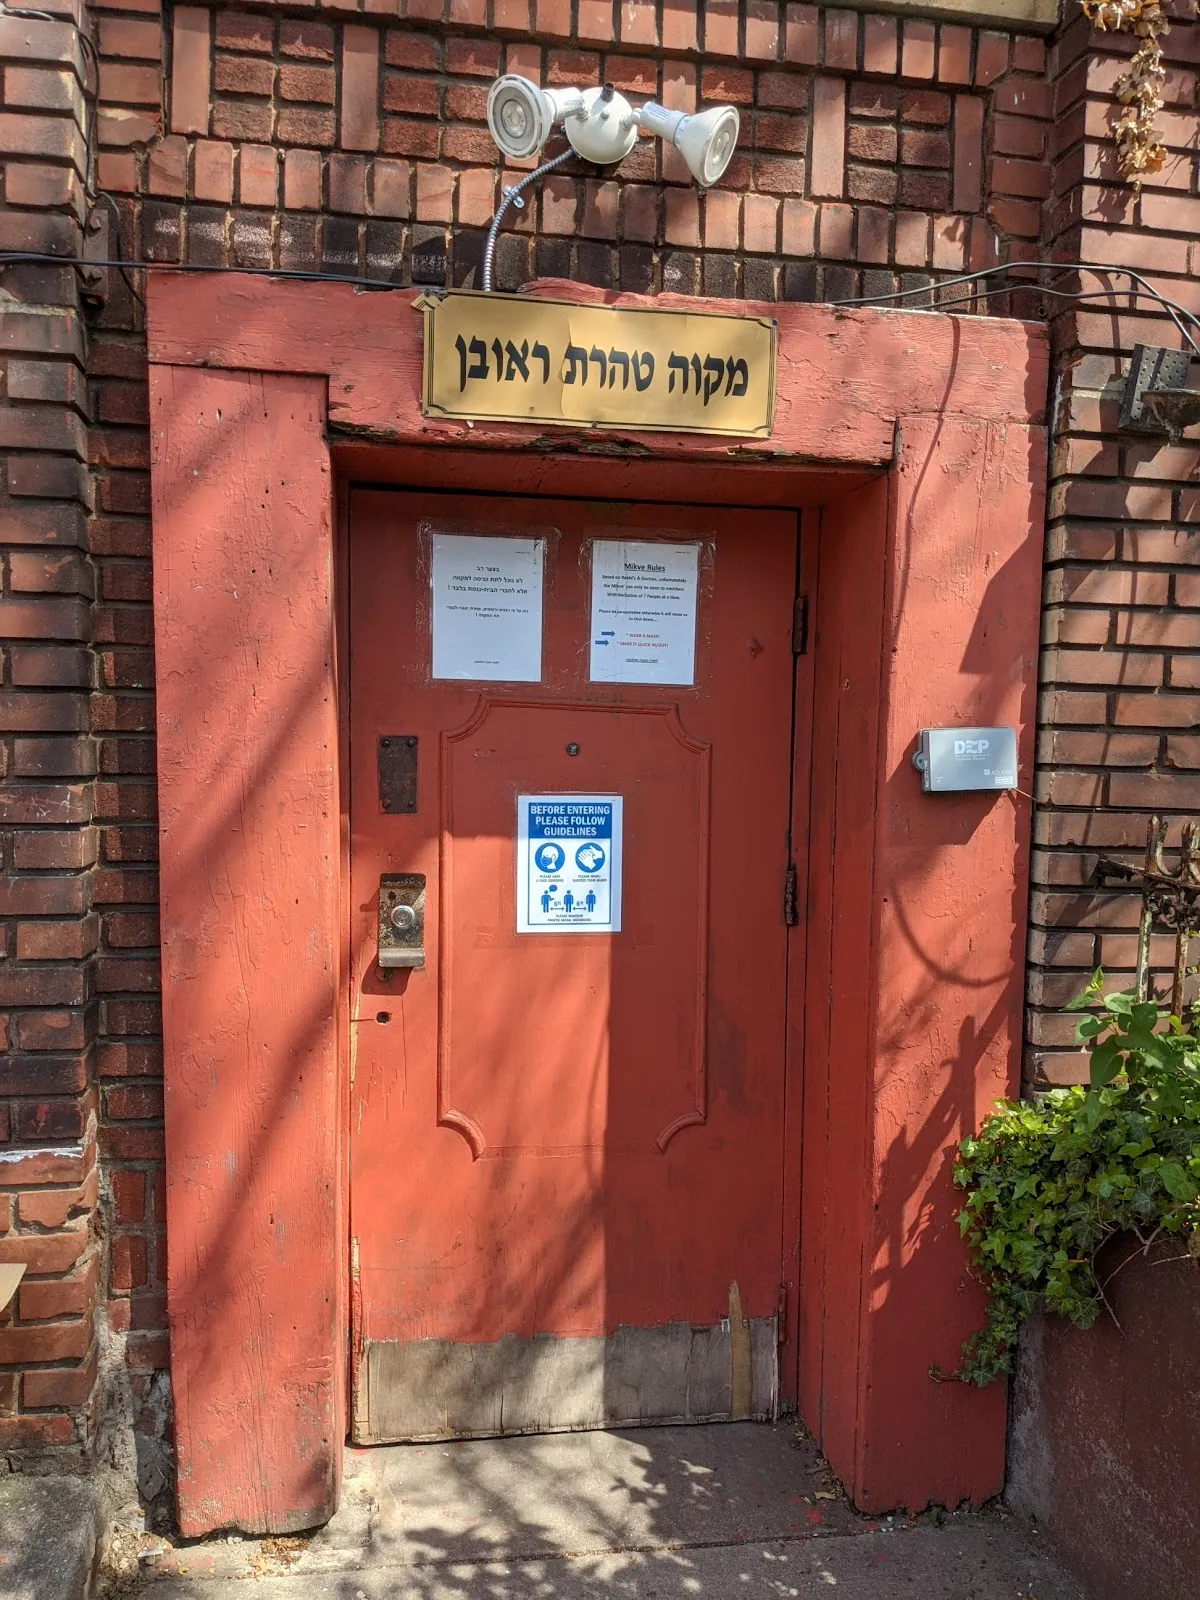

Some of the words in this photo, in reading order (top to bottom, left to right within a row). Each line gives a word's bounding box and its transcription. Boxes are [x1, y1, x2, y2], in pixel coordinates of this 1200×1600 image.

[454, 334, 550, 394] ראובן
[562, 344, 656, 393] טהרת
[668, 350, 749, 407] מקוה
[624, 562, 645, 571] Mikve
[647, 564, 666, 572] Rules
[531, 805, 565, 814] BEFORE
[567, 805, 610, 814] ENTERING
[535, 816, 569, 825] PLEASE
[571, 816, 606, 825] FOLLOW
[544, 827, 597, 836] GUIDELINES
